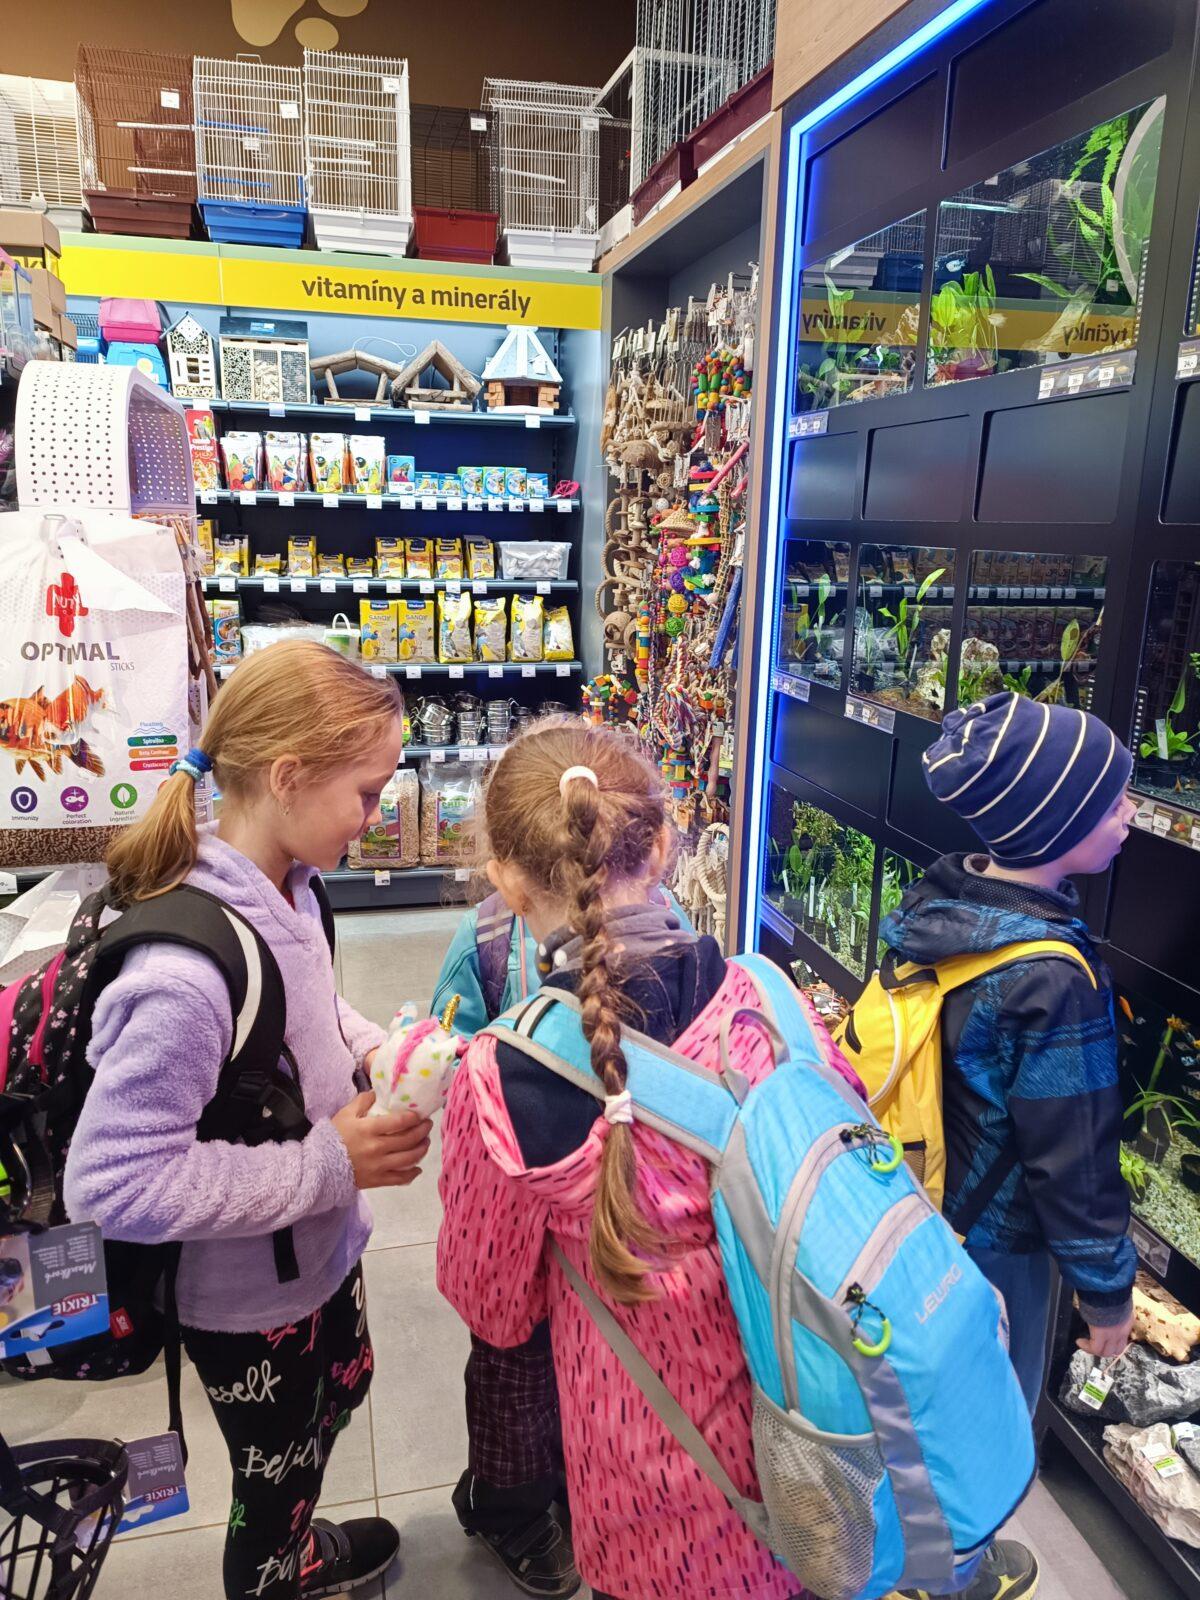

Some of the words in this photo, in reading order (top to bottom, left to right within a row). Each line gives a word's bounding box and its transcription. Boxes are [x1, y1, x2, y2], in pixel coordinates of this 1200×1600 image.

[302, 276, 407, 309] vitamíny
[412, 288, 425, 304] a
[430, 287, 531, 318] minerály
[110, 662, 135, 671] STICKS
[53, 1294, 98, 1316] TRIXIE
[145, 1486, 181, 1501] TRIXIE
